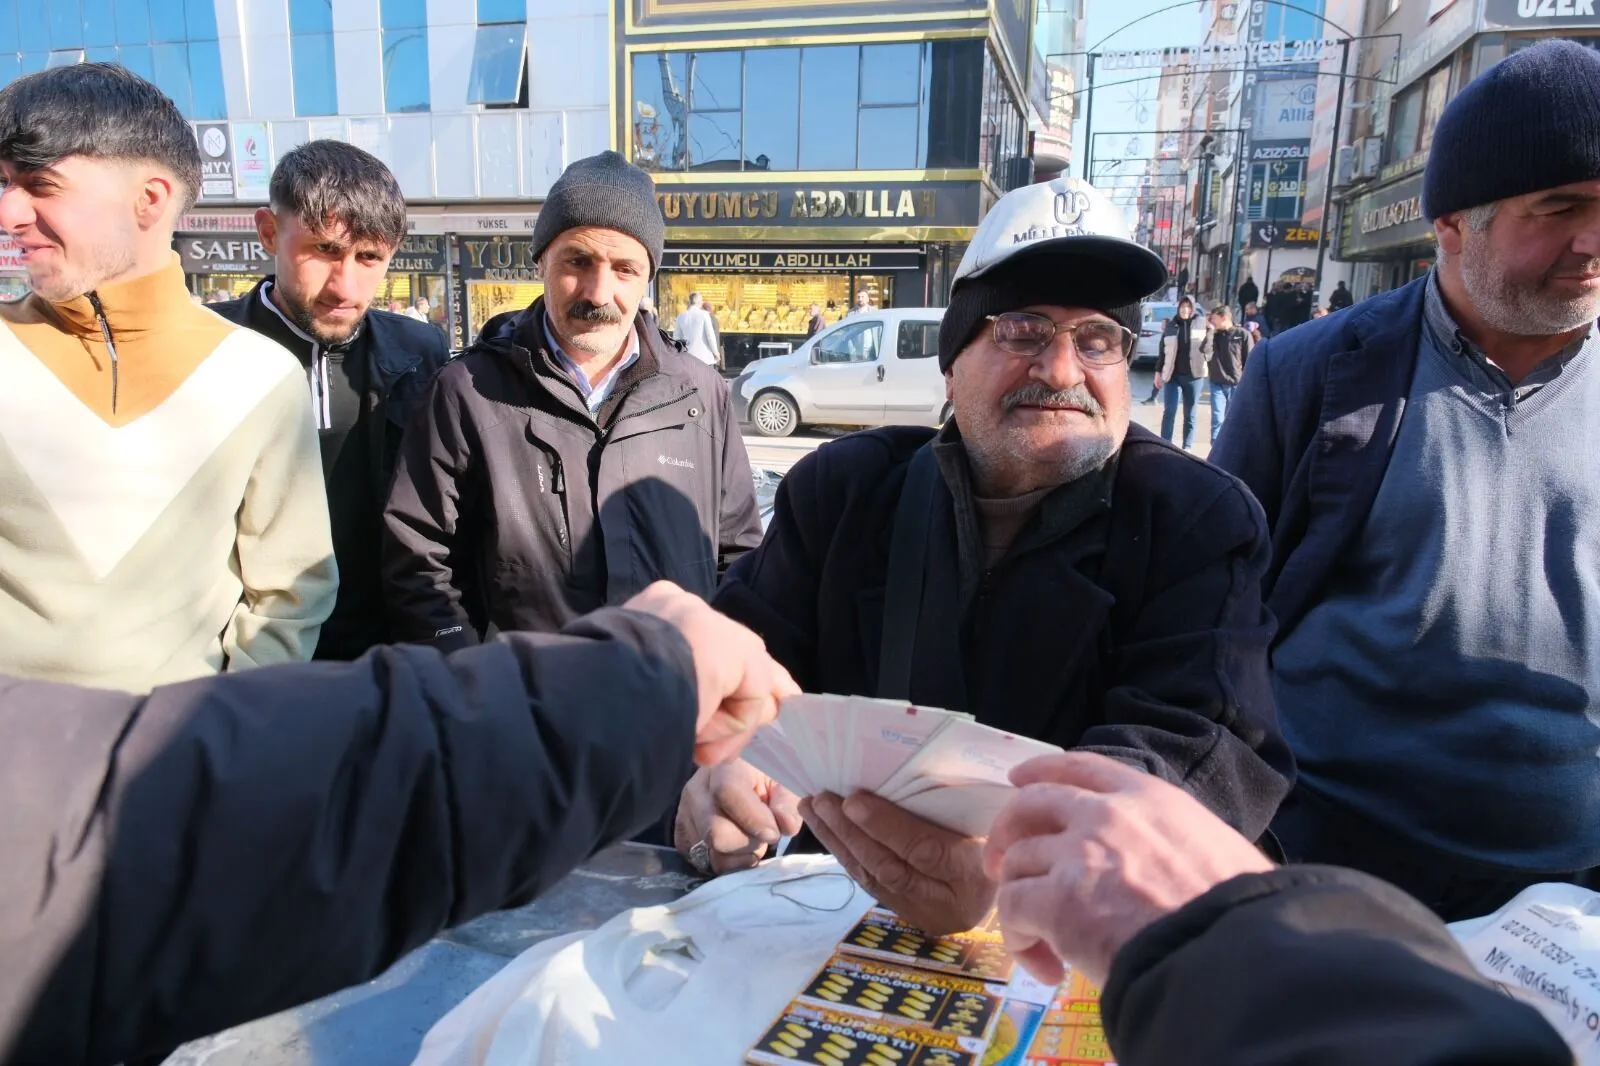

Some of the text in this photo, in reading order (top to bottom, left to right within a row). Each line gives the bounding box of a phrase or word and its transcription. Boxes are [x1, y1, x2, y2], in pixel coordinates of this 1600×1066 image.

[1278, 107, 1315, 122] Allia
[790, 189, 936, 218] ABDULLAH
[464, 236, 536, 268] YÜK
[679, 253, 871, 267] KUYUMCU ABDULLAH
